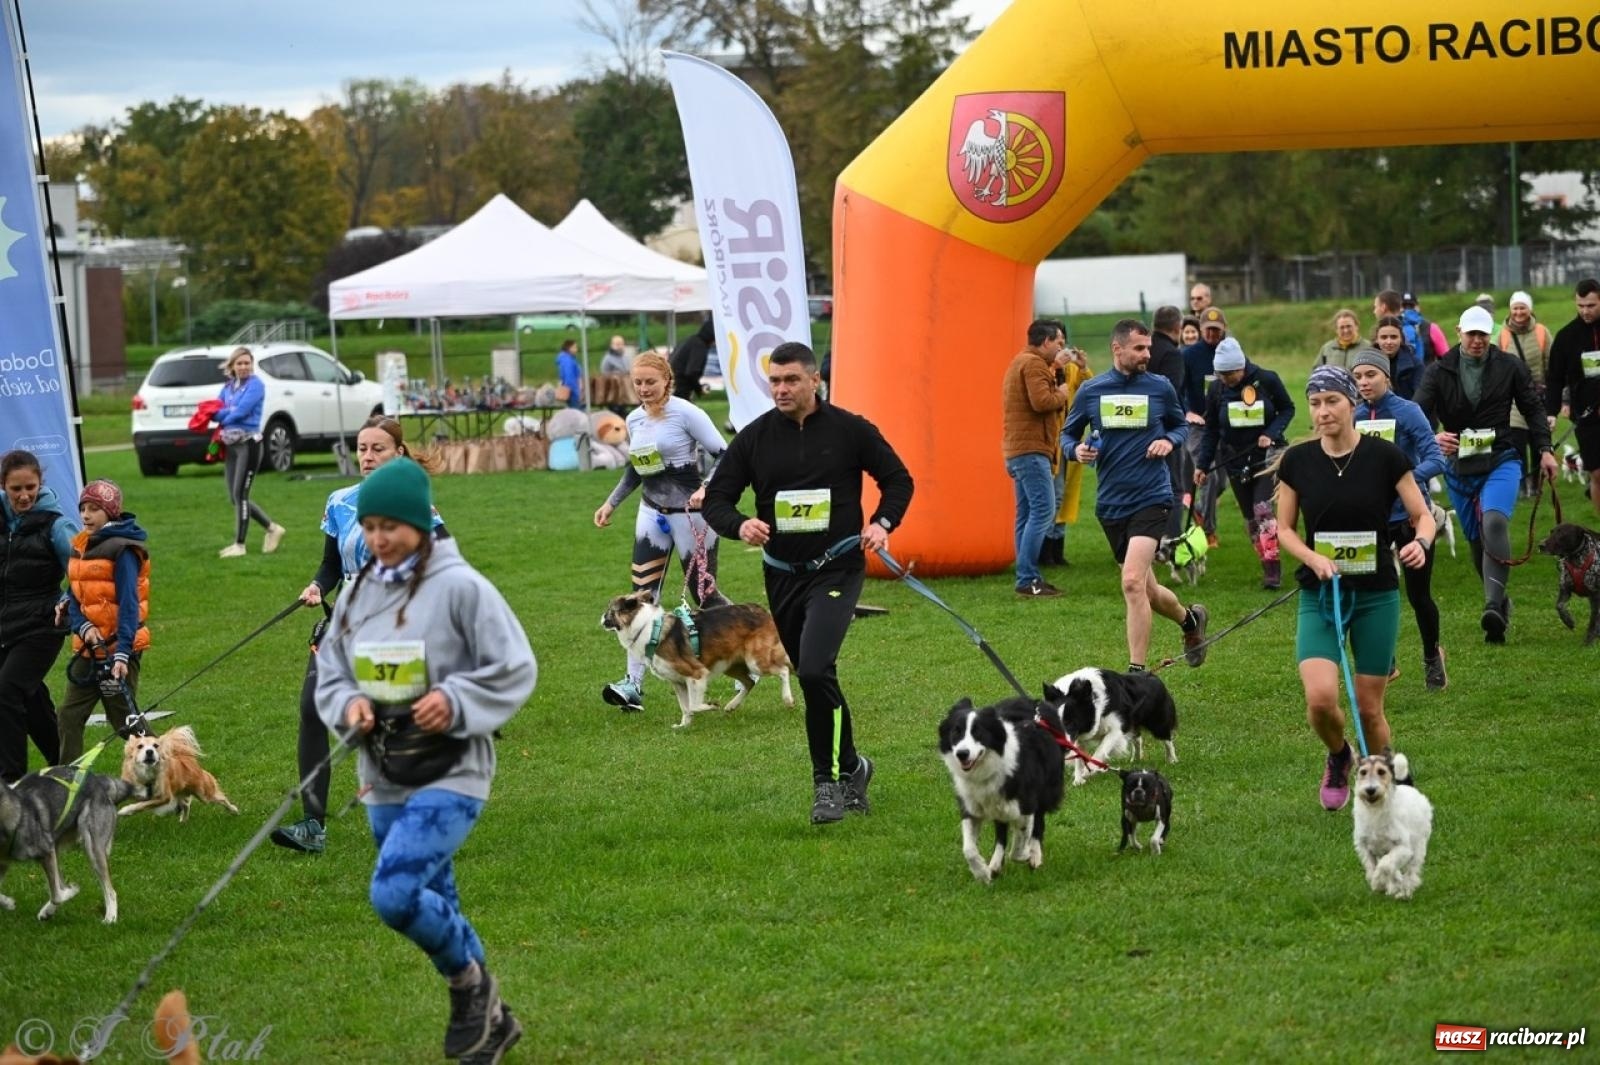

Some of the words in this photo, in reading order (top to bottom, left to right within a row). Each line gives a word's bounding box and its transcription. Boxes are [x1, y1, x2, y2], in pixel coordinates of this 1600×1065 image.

[1224, 25, 1411, 69] MIASTO
[1115, 405, 1134, 416] 26
[638, 455, 651, 466] 13
[791, 504, 814, 518] 27
[1334, 547, 1357, 560] 20
[375, 663, 401, 681] 37
